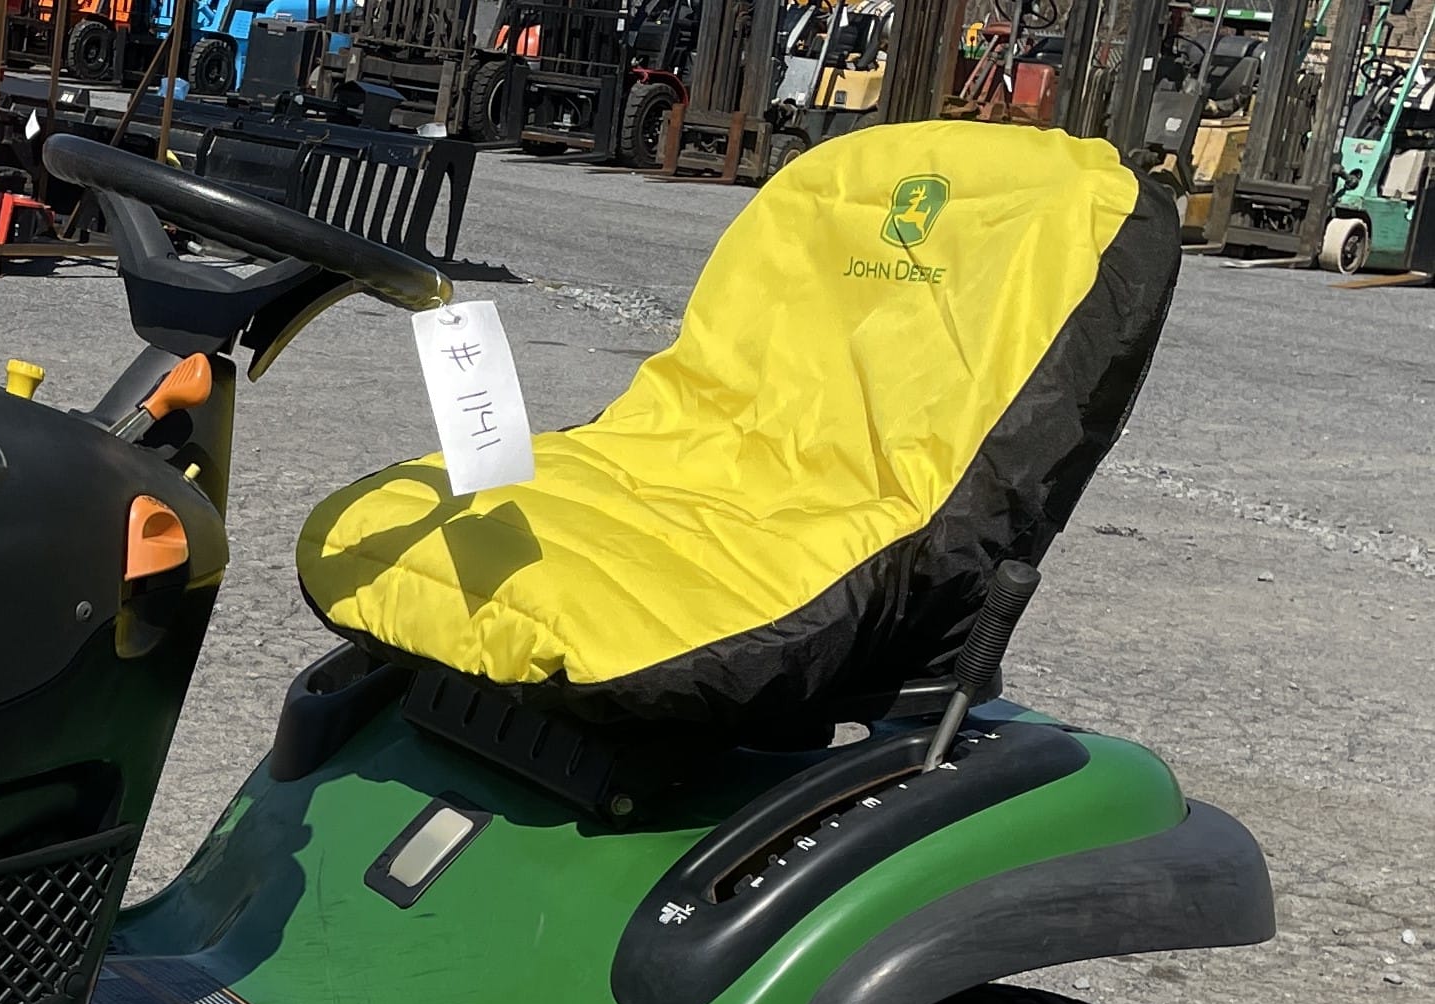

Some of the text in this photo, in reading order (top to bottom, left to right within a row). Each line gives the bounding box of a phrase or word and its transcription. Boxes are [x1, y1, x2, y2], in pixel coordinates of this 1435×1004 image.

[843, 256, 891, 280] JOHN
[457, 389, 502, 451] 1141
[796, 836, 817, 851] 2
